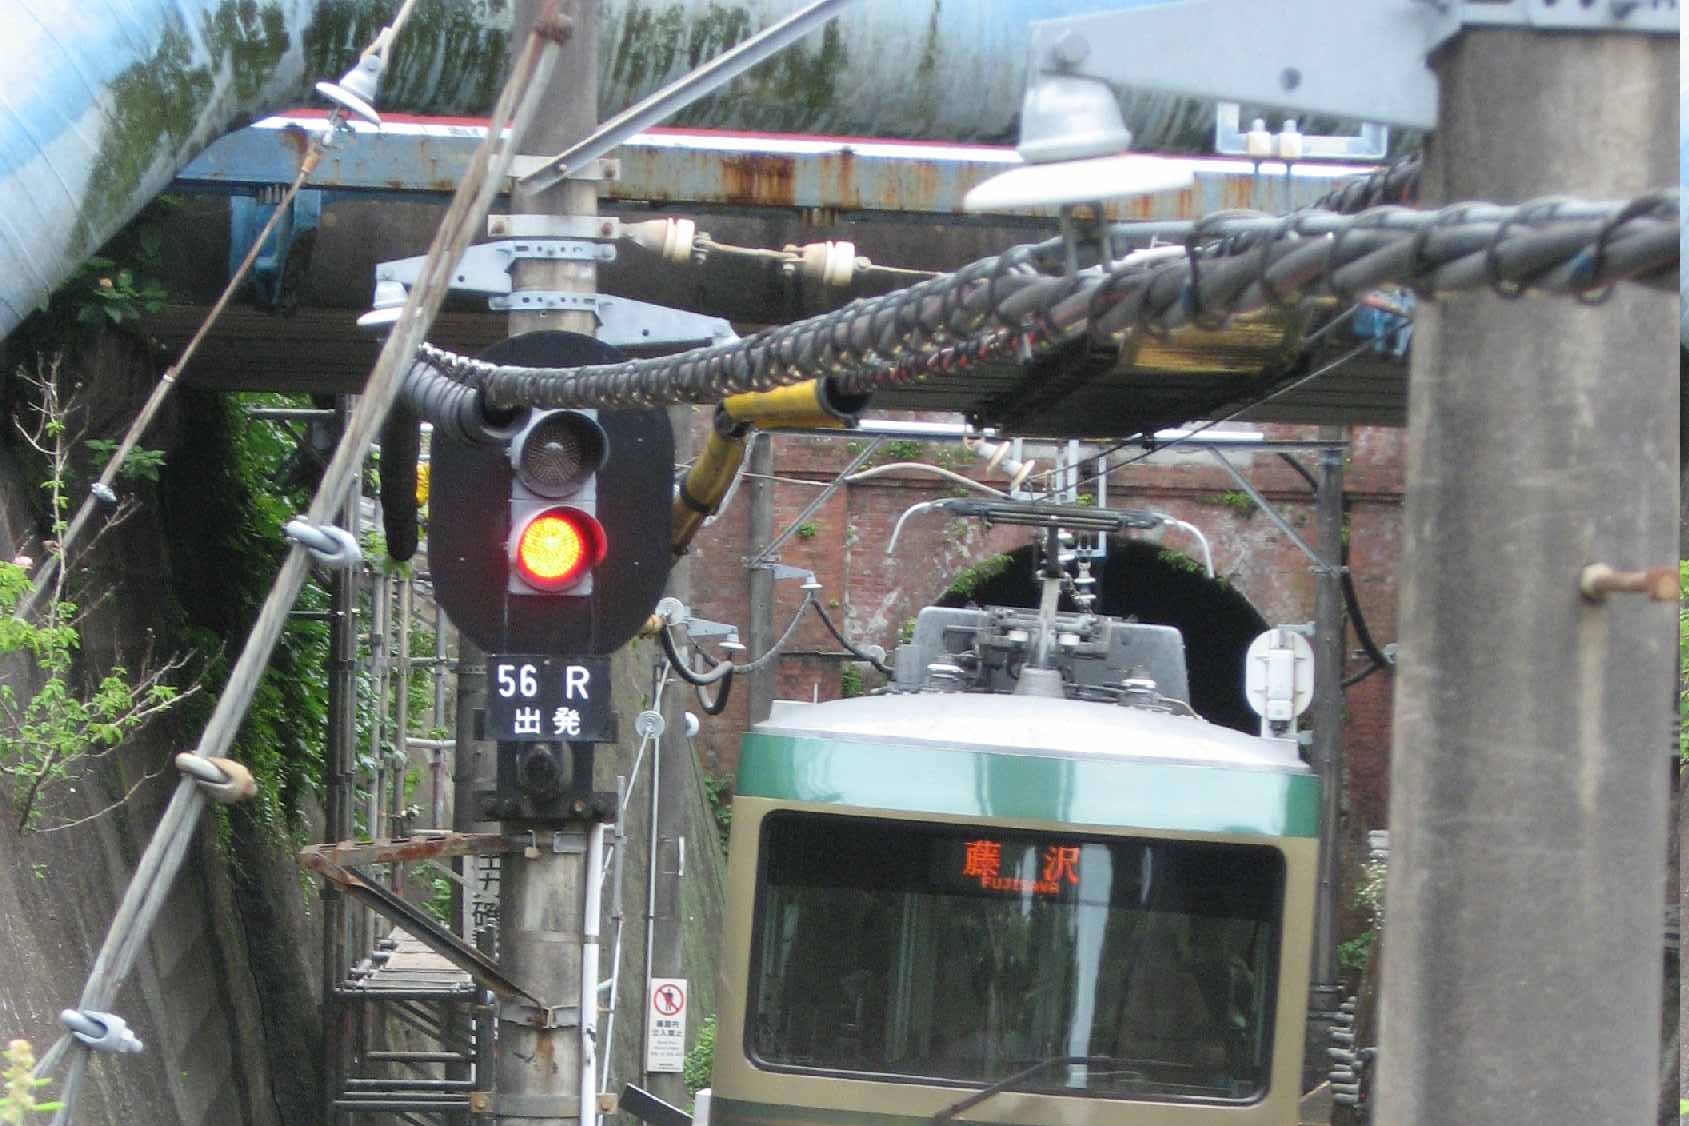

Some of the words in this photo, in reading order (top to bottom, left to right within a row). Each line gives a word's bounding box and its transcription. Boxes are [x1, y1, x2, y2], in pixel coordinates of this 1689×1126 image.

[497, 663, 538, 698] 56
[565, 664, 591, 700] R
[513, 706, 581, 736] 出発
[962, 840, 1081, 886] 藤沢
